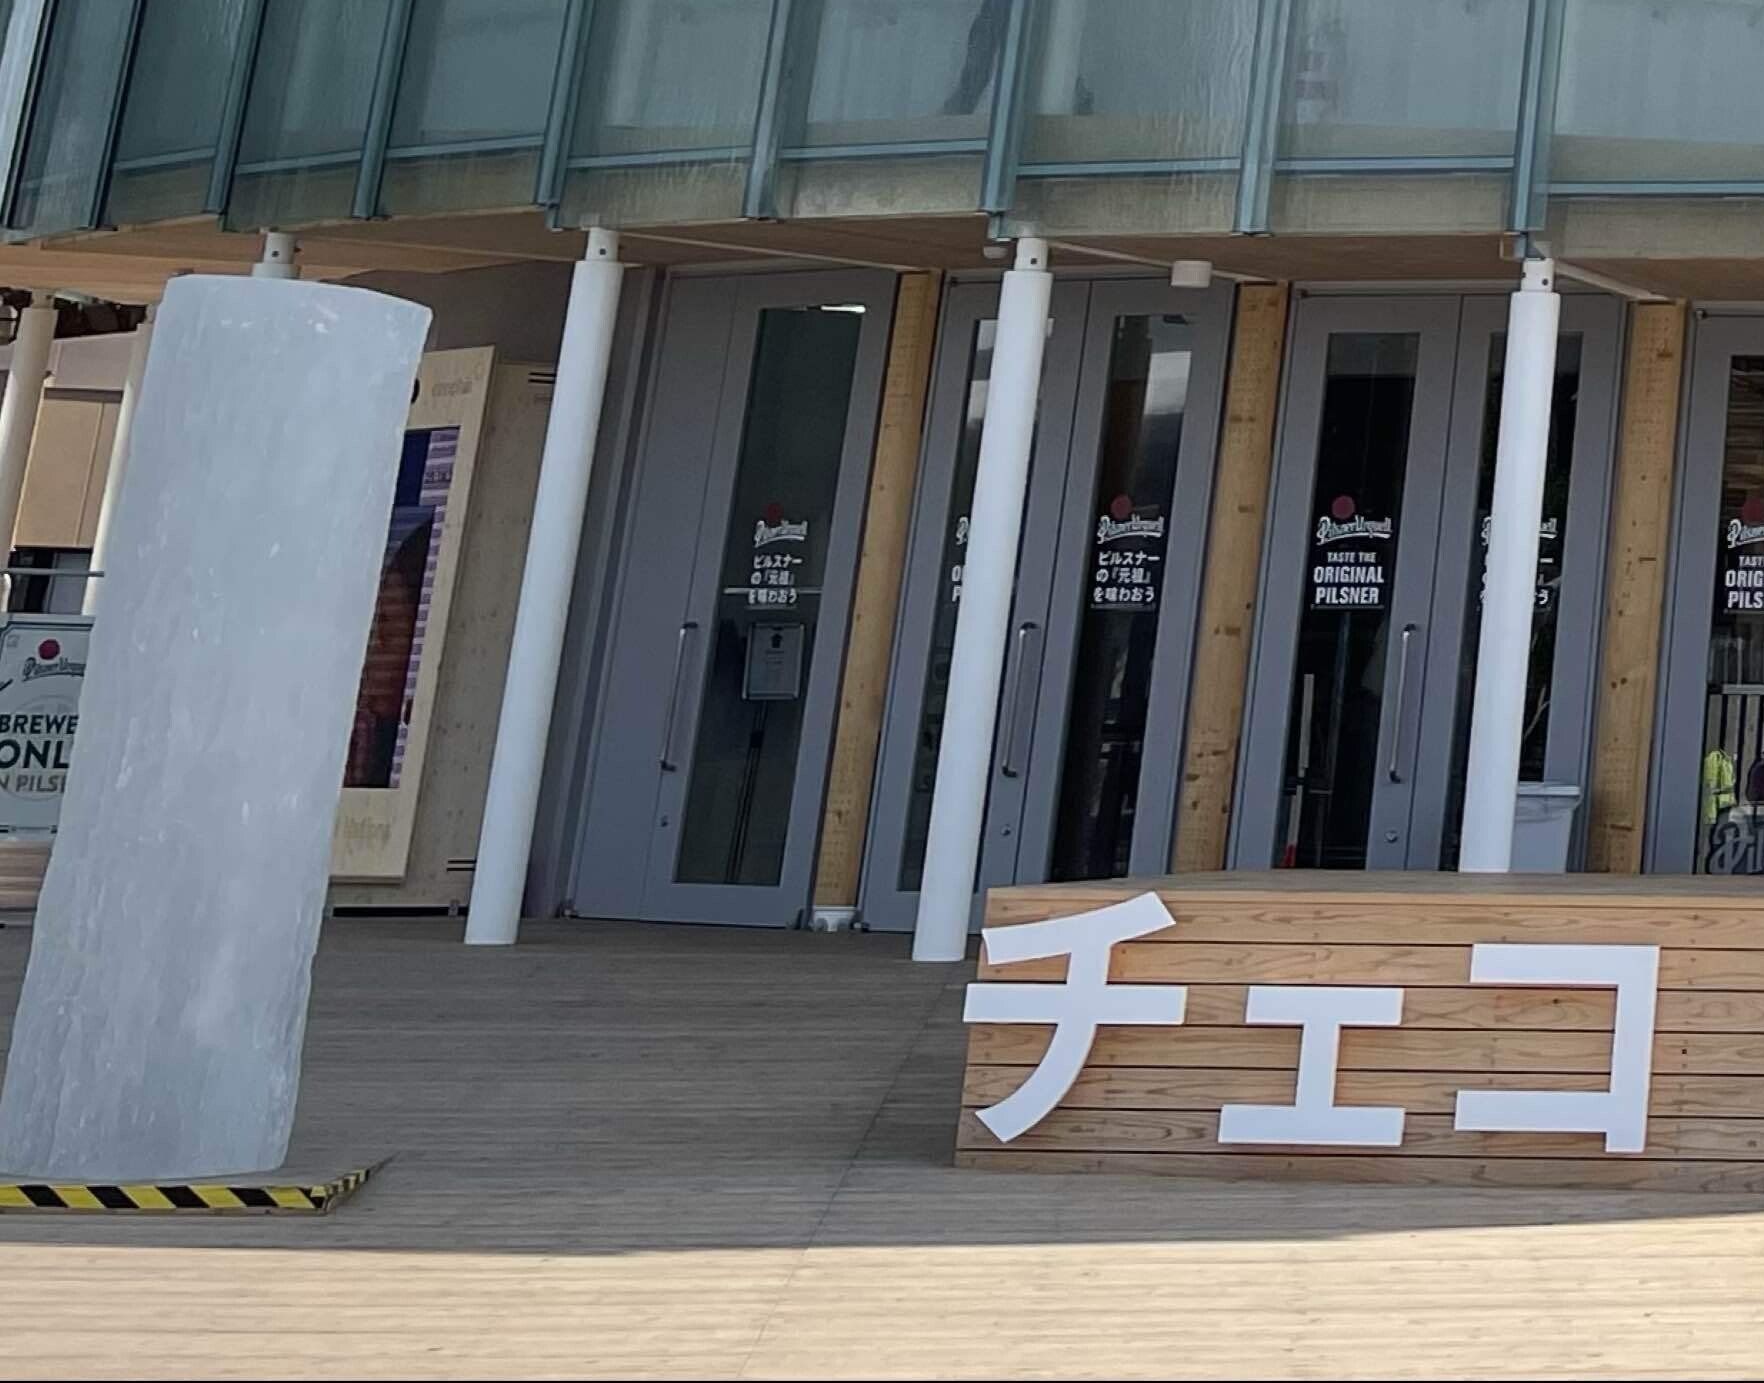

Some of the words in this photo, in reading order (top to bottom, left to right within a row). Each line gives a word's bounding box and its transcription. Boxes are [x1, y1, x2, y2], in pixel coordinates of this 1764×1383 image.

[1313, 566, 1384, 584] ORIGINAL
[1315, 587, 1379, 604] PILSNER
[0, 714, 79, 734] BREWE
[0, 739, 70, 768] ONL
[16, 774, 67, 793] PILS
[964, 890, 1661, 1153] チェコ
